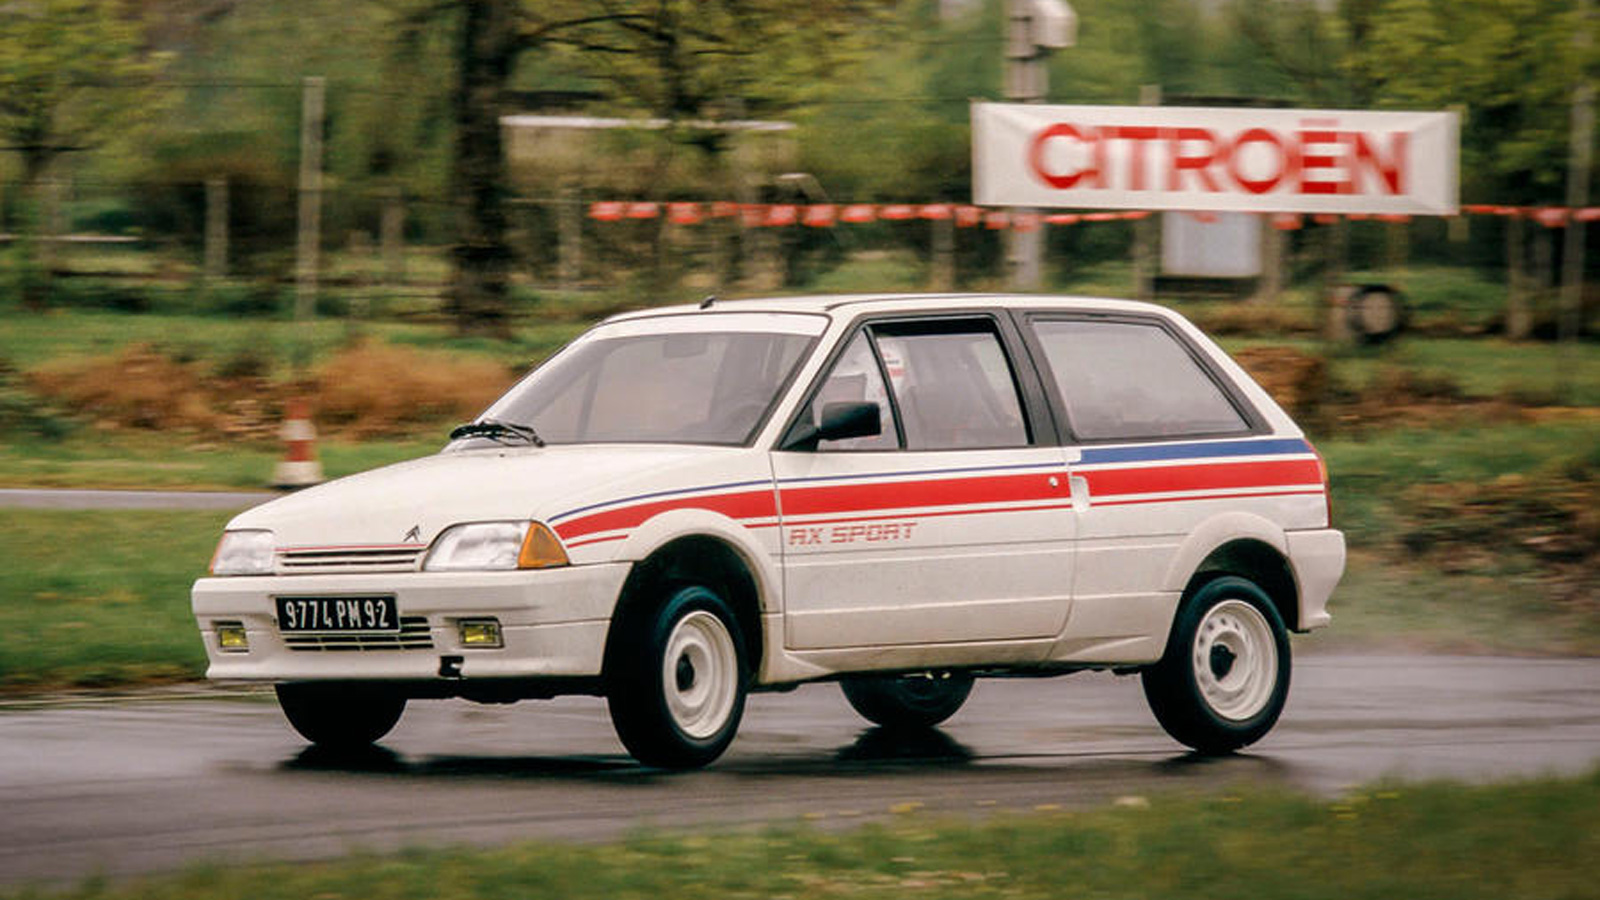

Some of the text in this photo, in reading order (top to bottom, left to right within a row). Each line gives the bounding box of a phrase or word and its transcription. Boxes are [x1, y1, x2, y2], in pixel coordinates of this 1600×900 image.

[1029, 119, 1411, 195] CITROËN
[789, 522, 918, 545] AX SPORT
